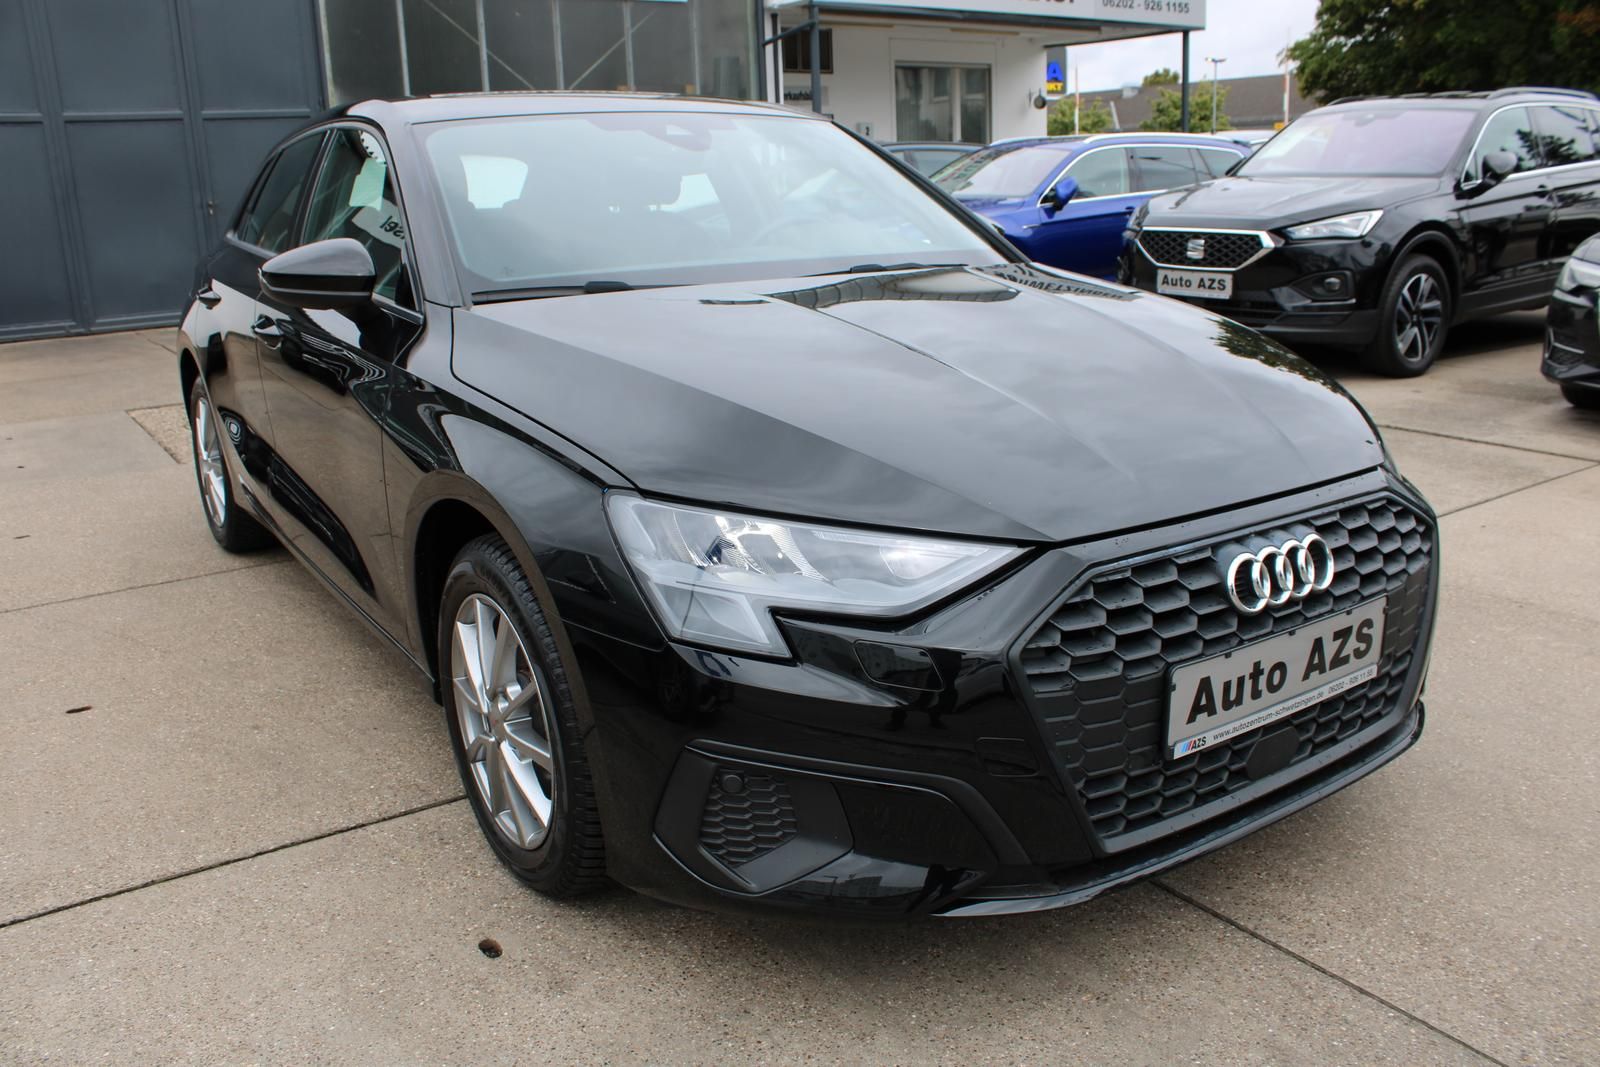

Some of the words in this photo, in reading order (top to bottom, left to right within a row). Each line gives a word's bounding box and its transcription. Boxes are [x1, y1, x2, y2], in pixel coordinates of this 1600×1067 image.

[1102, 0, 1134, 9] 06202
[1144, 0, 1162, 11] 926
[1166, 2, 1190, 13] 1155
[1161, 274, 1192, 288] Auto
[1197, 277, 1226, 291] AZS
[1186, 660, 1288, 725] Auto
[1301, 618, 1374, 682] AZS
[1213, 692, 1324, 741] www.autozentrum-schwetzingen.de
[1192, 736, 1207, 751] AZS
